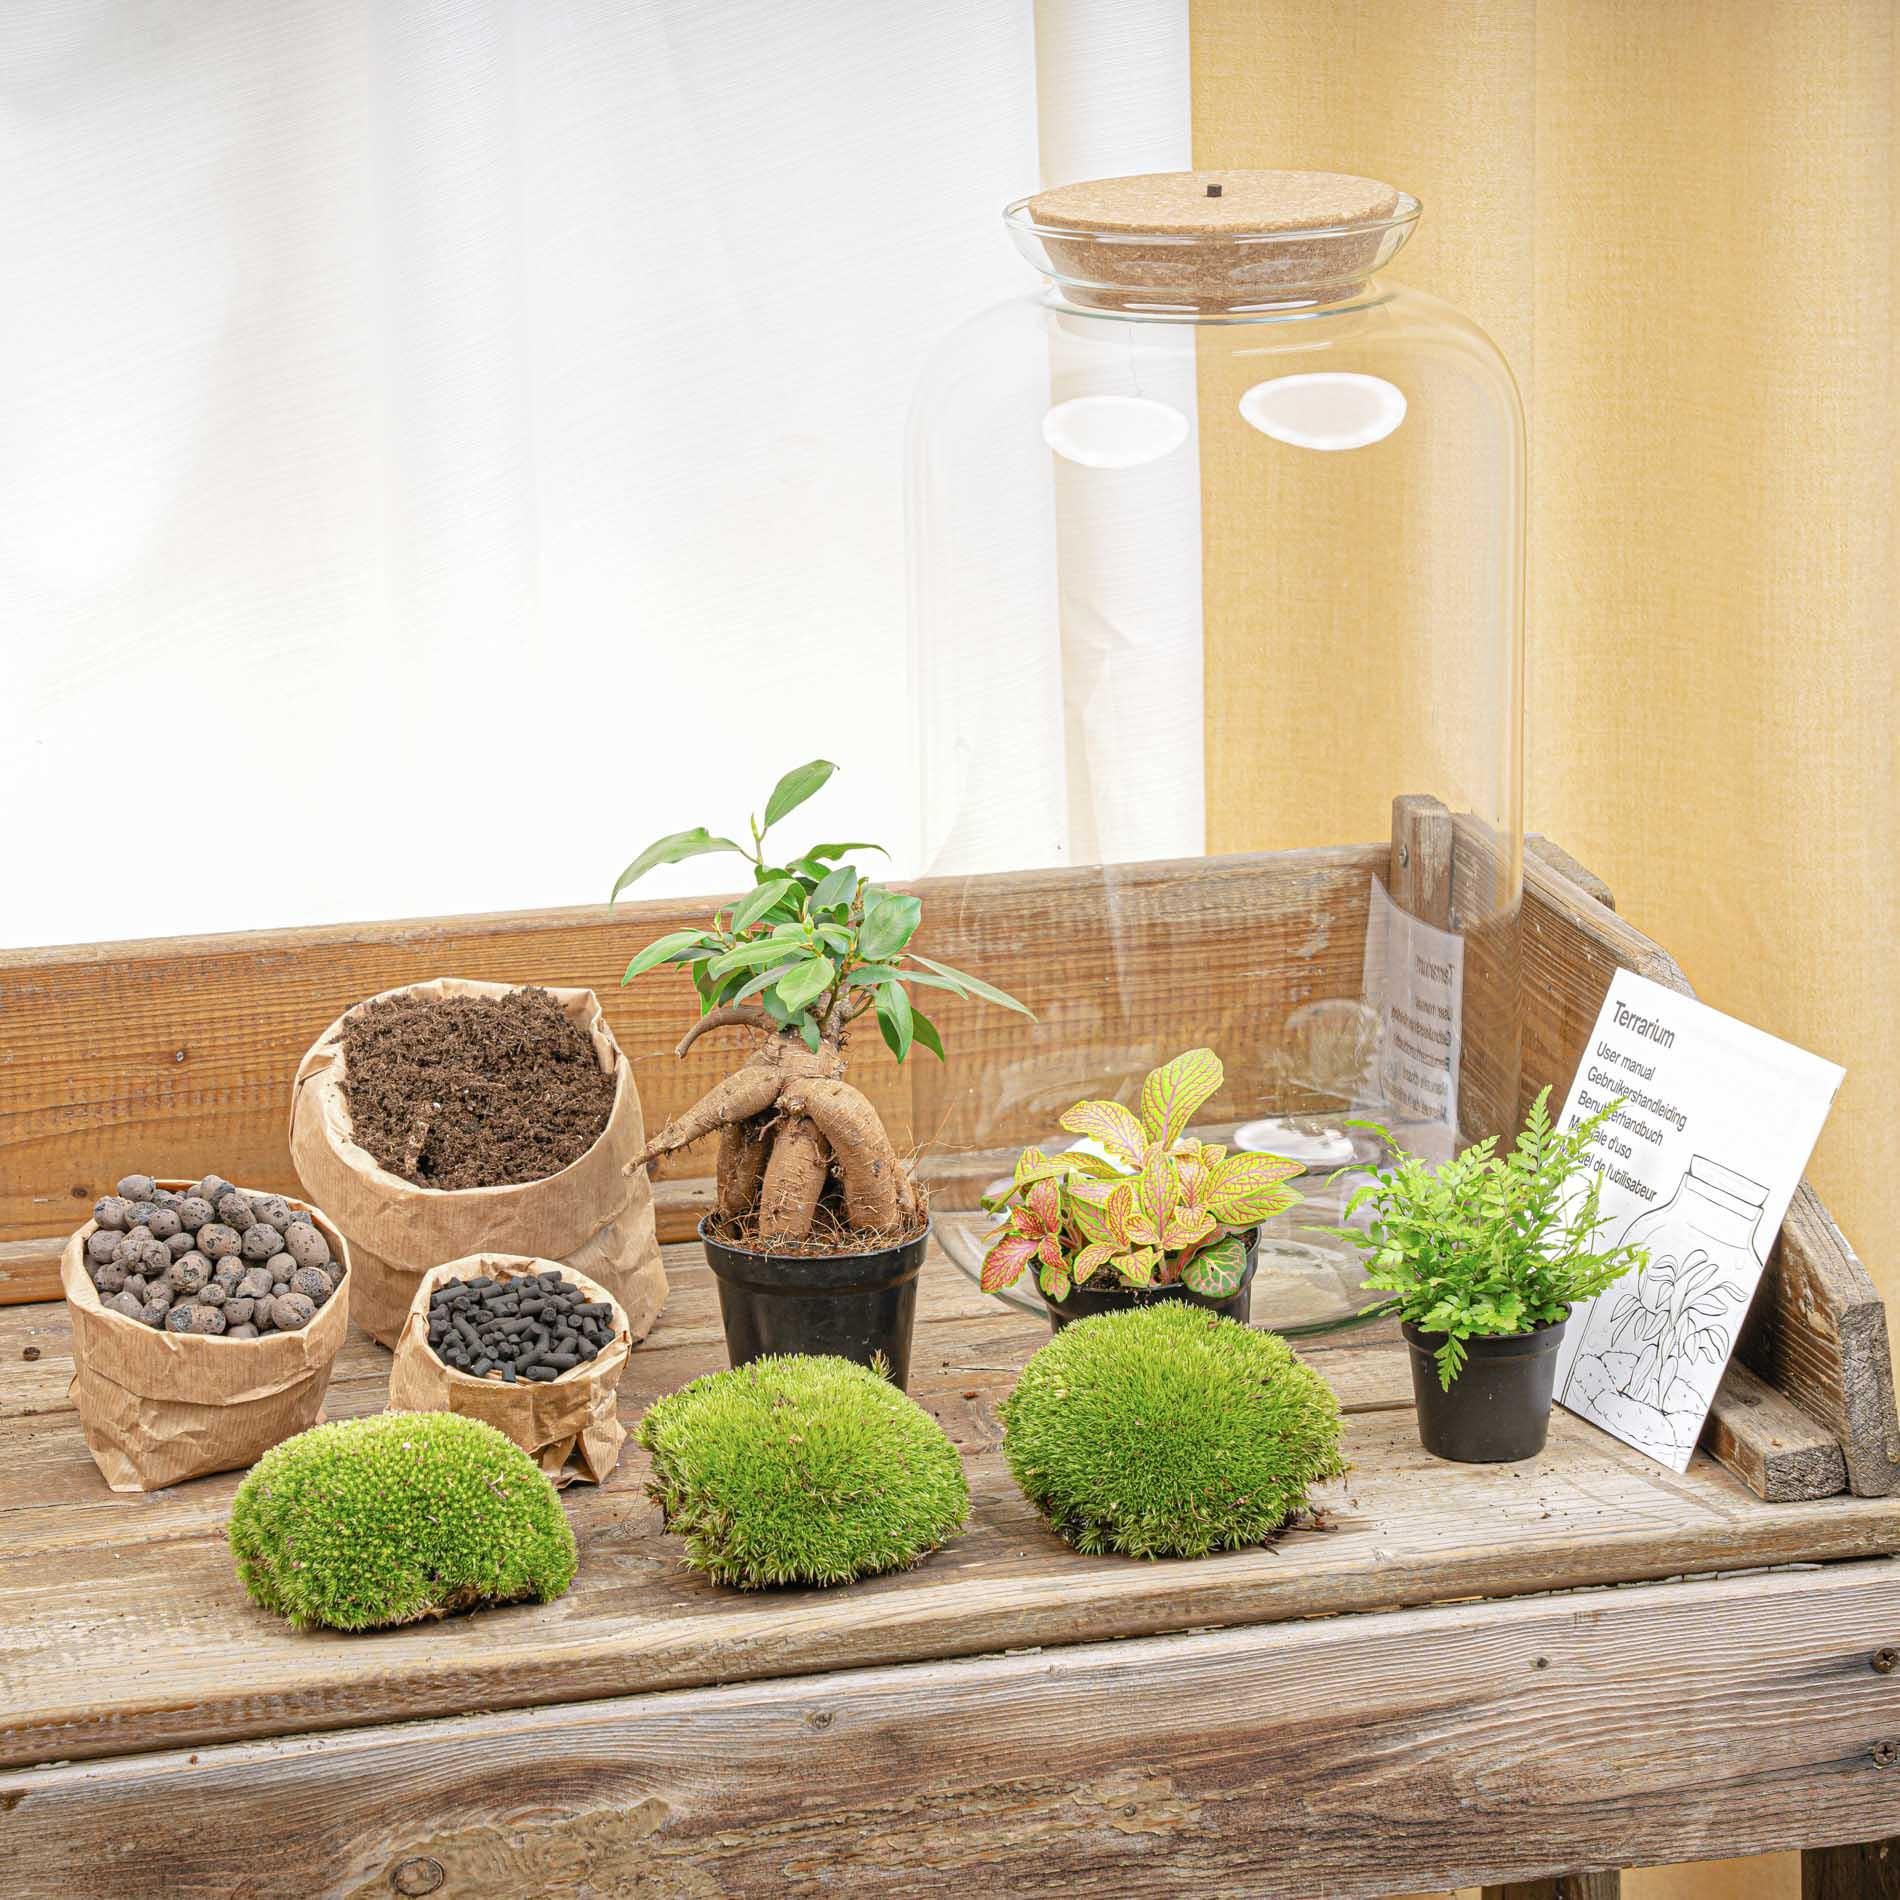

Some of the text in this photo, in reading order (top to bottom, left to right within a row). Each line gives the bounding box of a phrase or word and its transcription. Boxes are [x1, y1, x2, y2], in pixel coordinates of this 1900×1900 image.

[1611, 1000, 1676, 1049] Terrarium
[1596, 1040, 1656, 1081] User manual
[1587, 1066, 1688, 1132] Gebruikershandleiding
[1568, 1114, 1632, 1159] Maale d'uso
[1559, 1143, 1658, 1202] Muel de l'utilisateur
